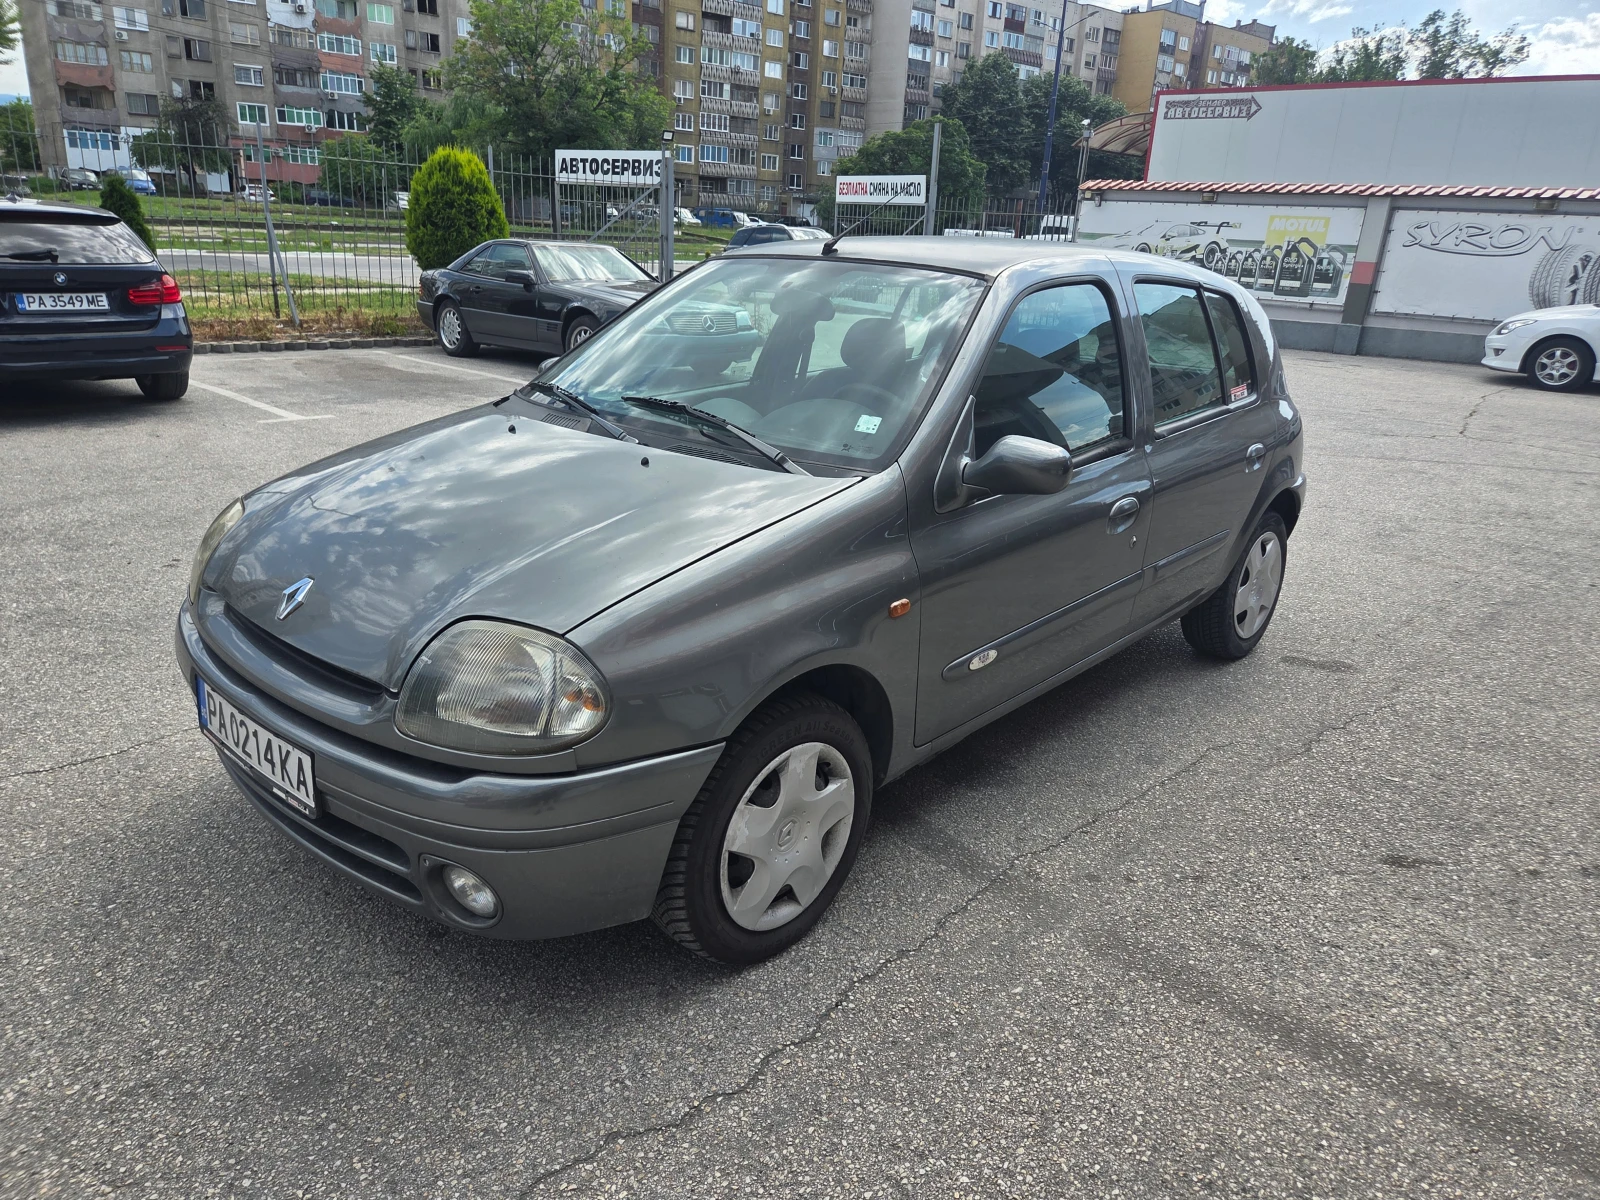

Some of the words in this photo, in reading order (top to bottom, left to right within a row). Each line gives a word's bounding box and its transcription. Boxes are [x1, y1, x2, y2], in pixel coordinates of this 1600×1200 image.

[1167, 106, 1248, 118] АВТОСЕРВИЗ
[559, 157, 662, 177] АВТОСЕРВИЗ
[839, 182, 868, 195] БЕЗПЛАТНА
[869, 182, 889, 196] СМЯНА
[891, 182, 898, 196] НА
[900, 182, 921, 196] МАСЛО
[1270, 217, 1326, 232] MOTUL
[1402, 221, 1575, 257] SYRON
